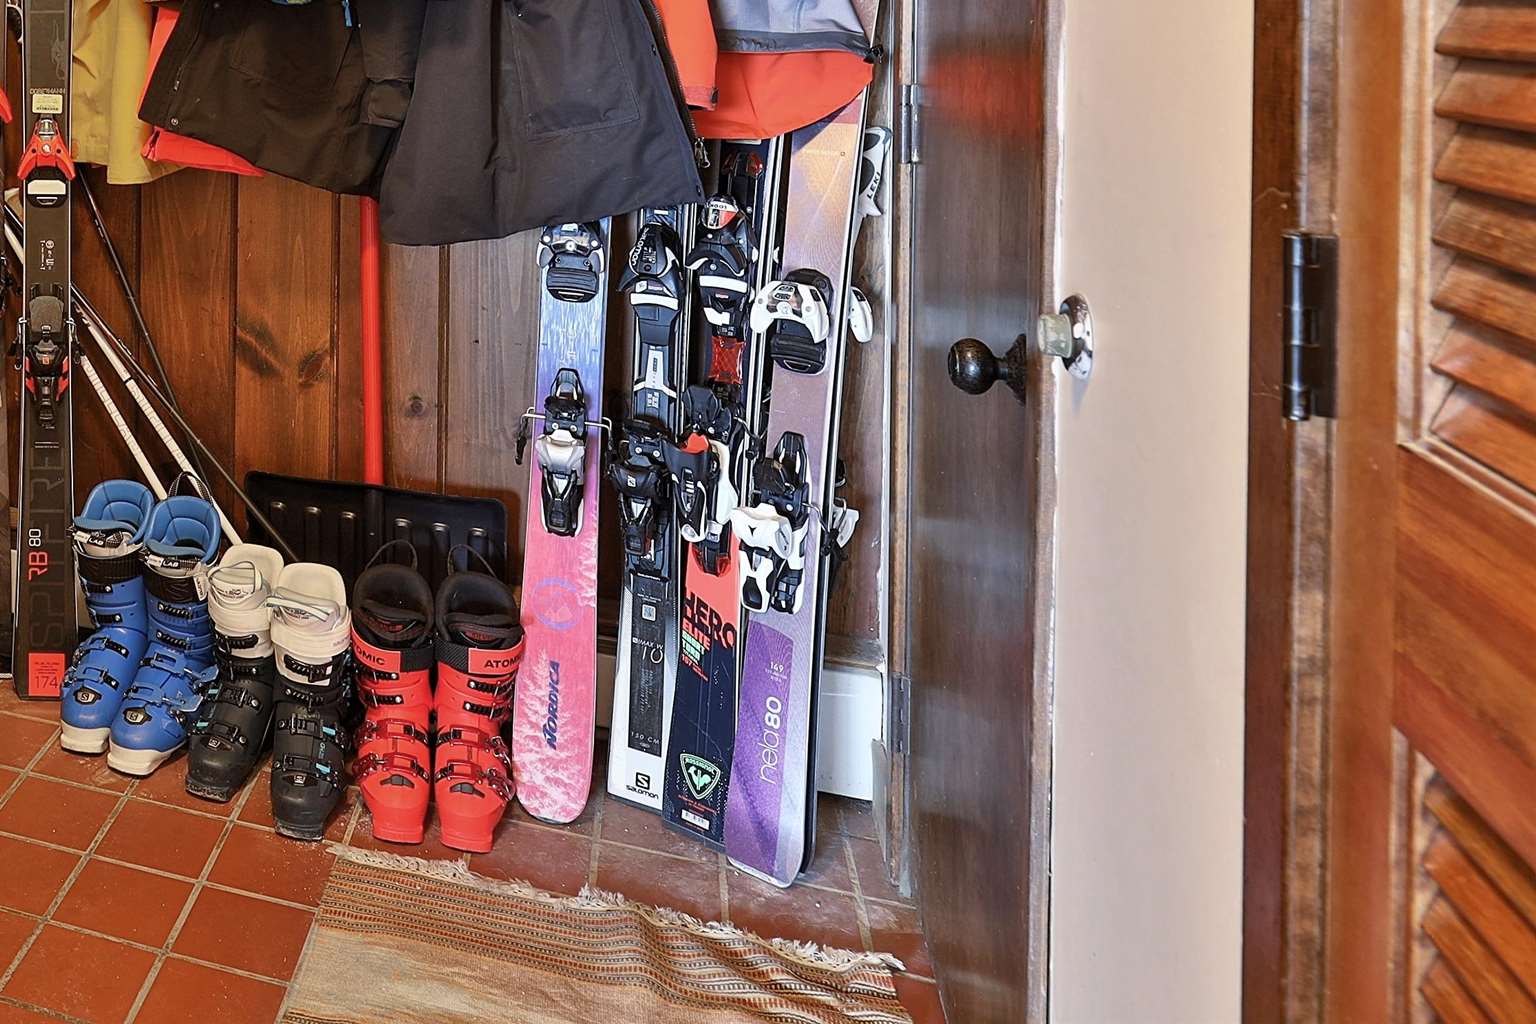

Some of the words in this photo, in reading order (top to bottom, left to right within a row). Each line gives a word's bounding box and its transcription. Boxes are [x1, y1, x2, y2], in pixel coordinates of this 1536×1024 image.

[867, 171, 881, 200] LEKI
[28, 528, 42, 547] 80
[29, 551, 48, 581] RB
[162, 560, 180, 568] LAB
[684, 591, 738, 649] HERO
[683, 621, 711, 651] ELITE
[353, 642, 385, 665] OMIC
[770, 661, 784, 673] 149
[35, 676, 58, 688] 174
[542, 660, 560, 751] NORDICA
[631, 730, 645, 741] 150
[647, 736, 661, 746] CM
